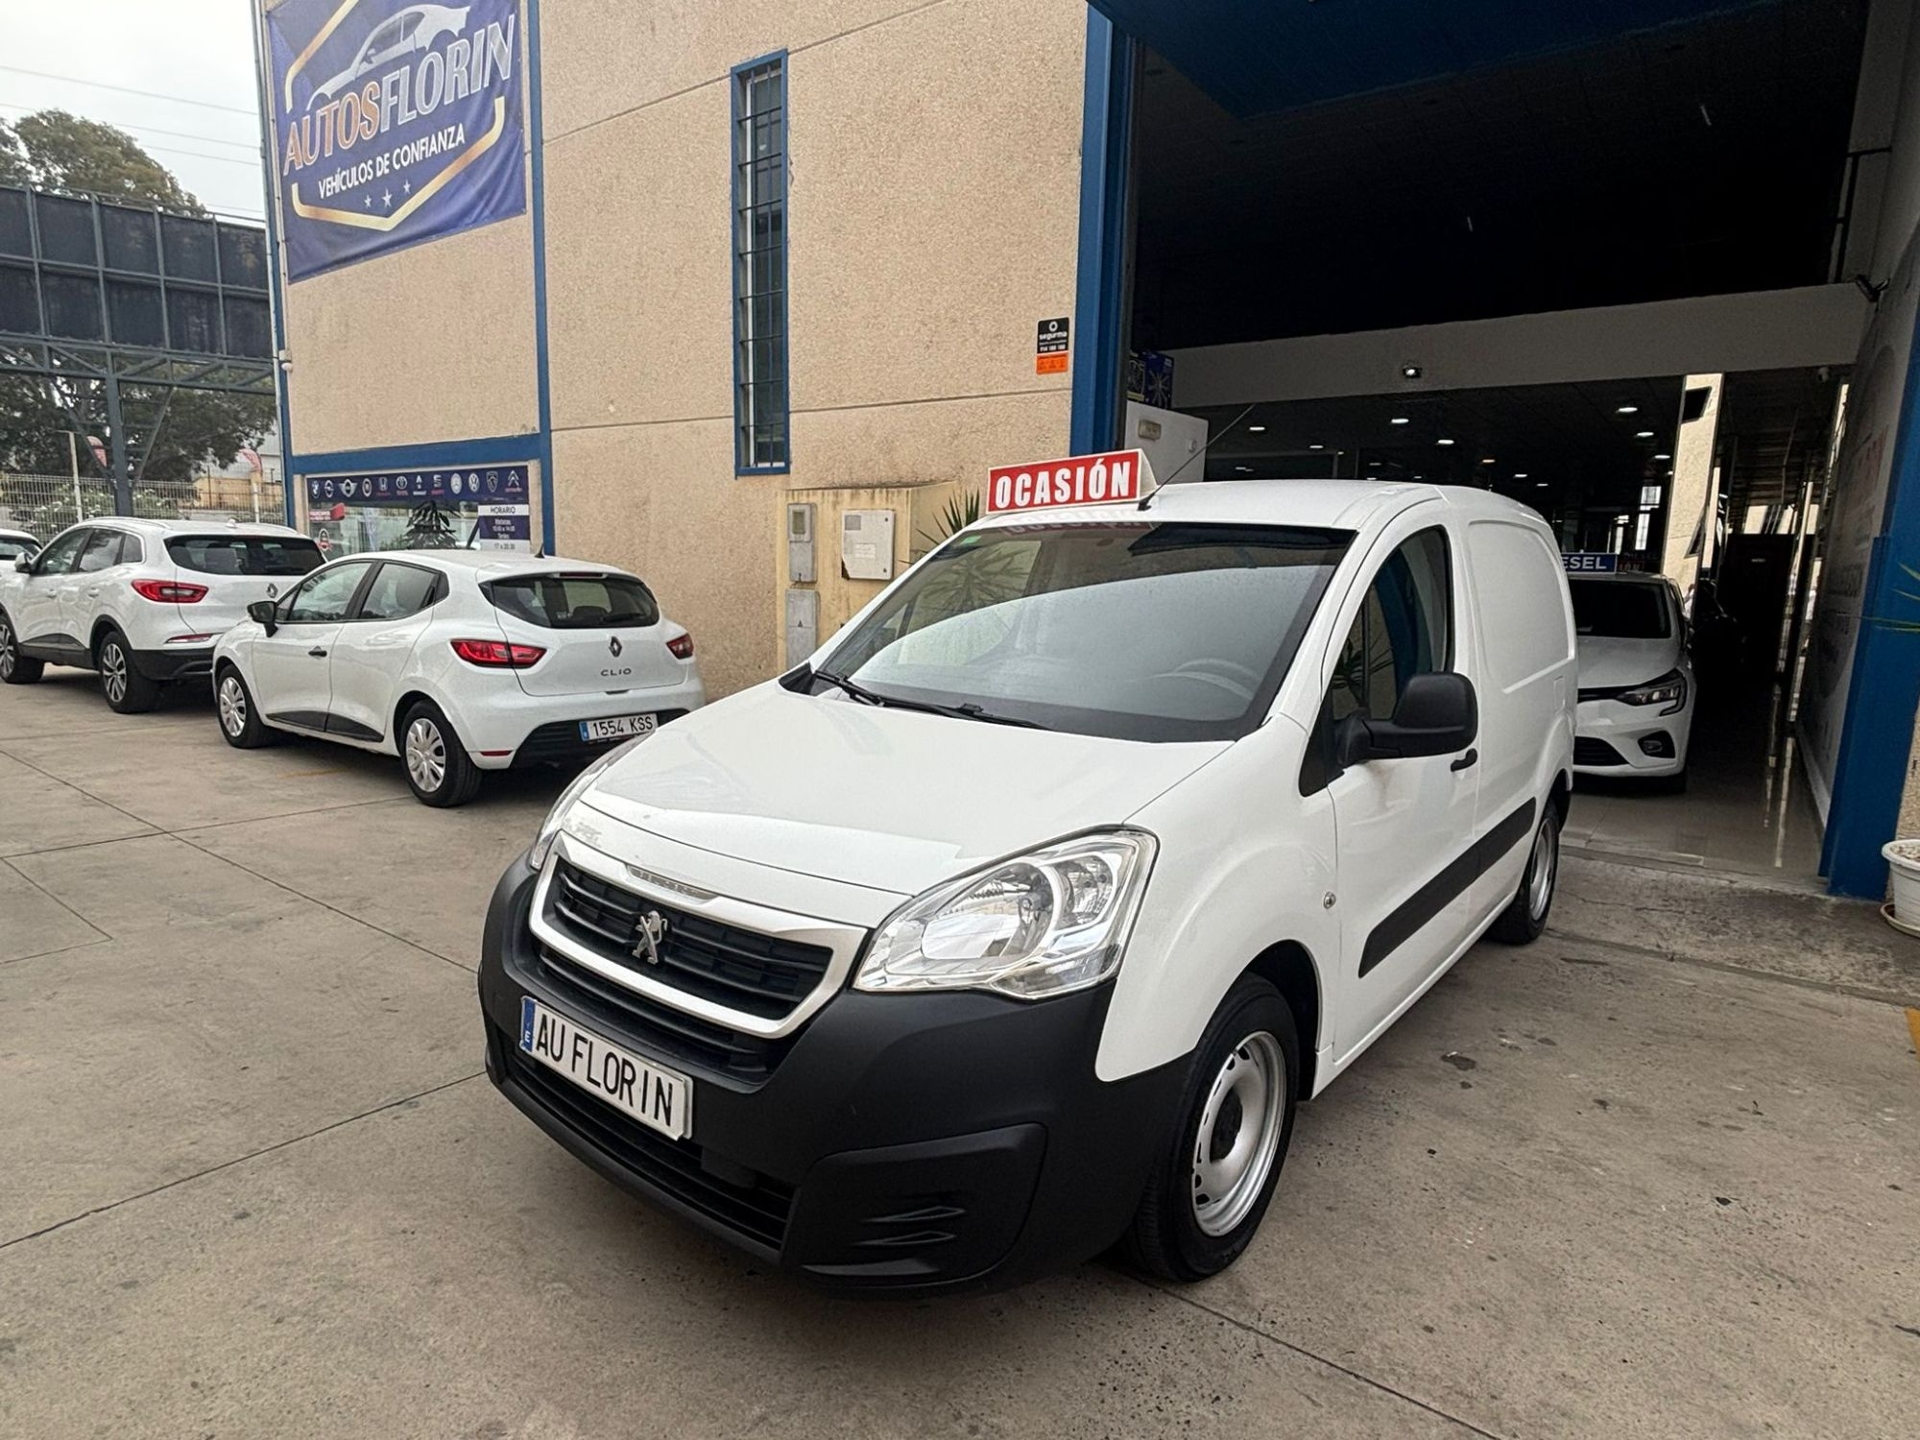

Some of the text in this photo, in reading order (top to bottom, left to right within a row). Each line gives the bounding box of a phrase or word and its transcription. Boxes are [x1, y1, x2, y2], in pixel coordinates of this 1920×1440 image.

[283, 14, 515, 176] AUTOSFLORIN
[318, 123, 465, 199] VEHÍCULOS DE CONFIANZA
[995, 458, 1131, 508] OCASIÓN
[490, 506, 516, 514] HORARIO
[1562, 556, 1607, 570] ESEL
[601, 668, 632, 676] CLIO
[593, 716, 654, 737] 1554 KSS
[536, 1013, 673, 1127] AU FLORIN
